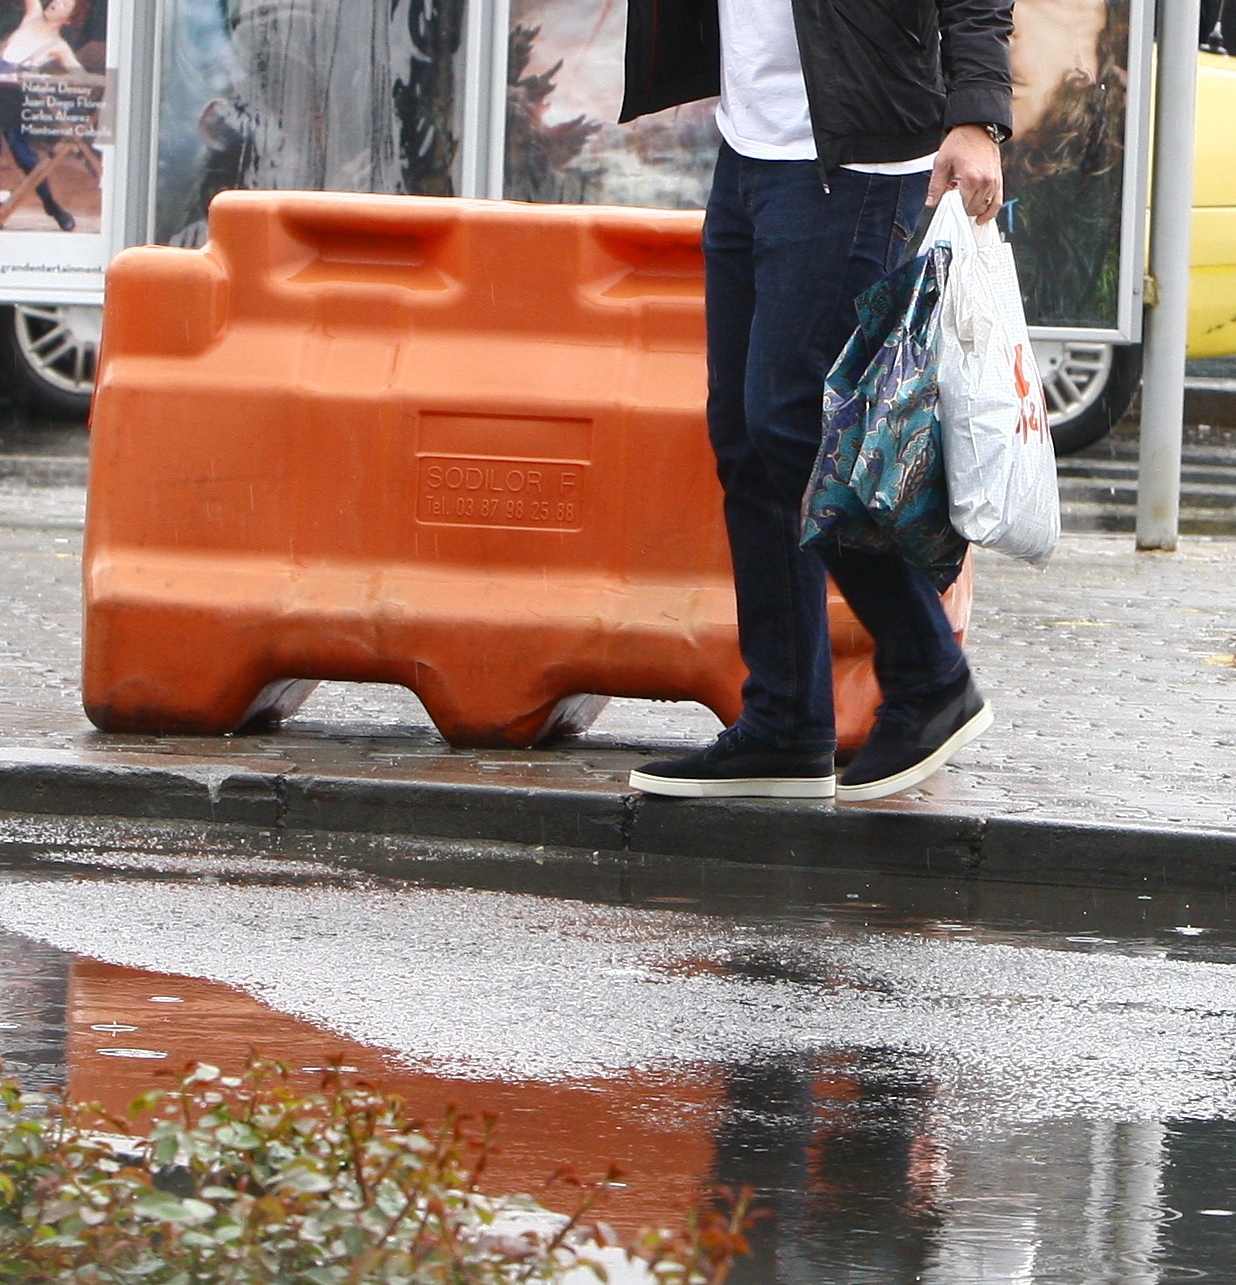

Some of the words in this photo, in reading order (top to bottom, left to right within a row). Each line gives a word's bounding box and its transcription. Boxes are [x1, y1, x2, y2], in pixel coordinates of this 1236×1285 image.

[426, 466, 543, 492] SODILOR
[560, 472, 576, 494] F
[425, 496, 449, 515] Tel.
[456, 497, 474, 517] 03
[481, 499, 499, 517] 87
[506, 500, 524, 519] 98
[531, 501, 549, 520] 25
[556, 503, 574, 522] 88
